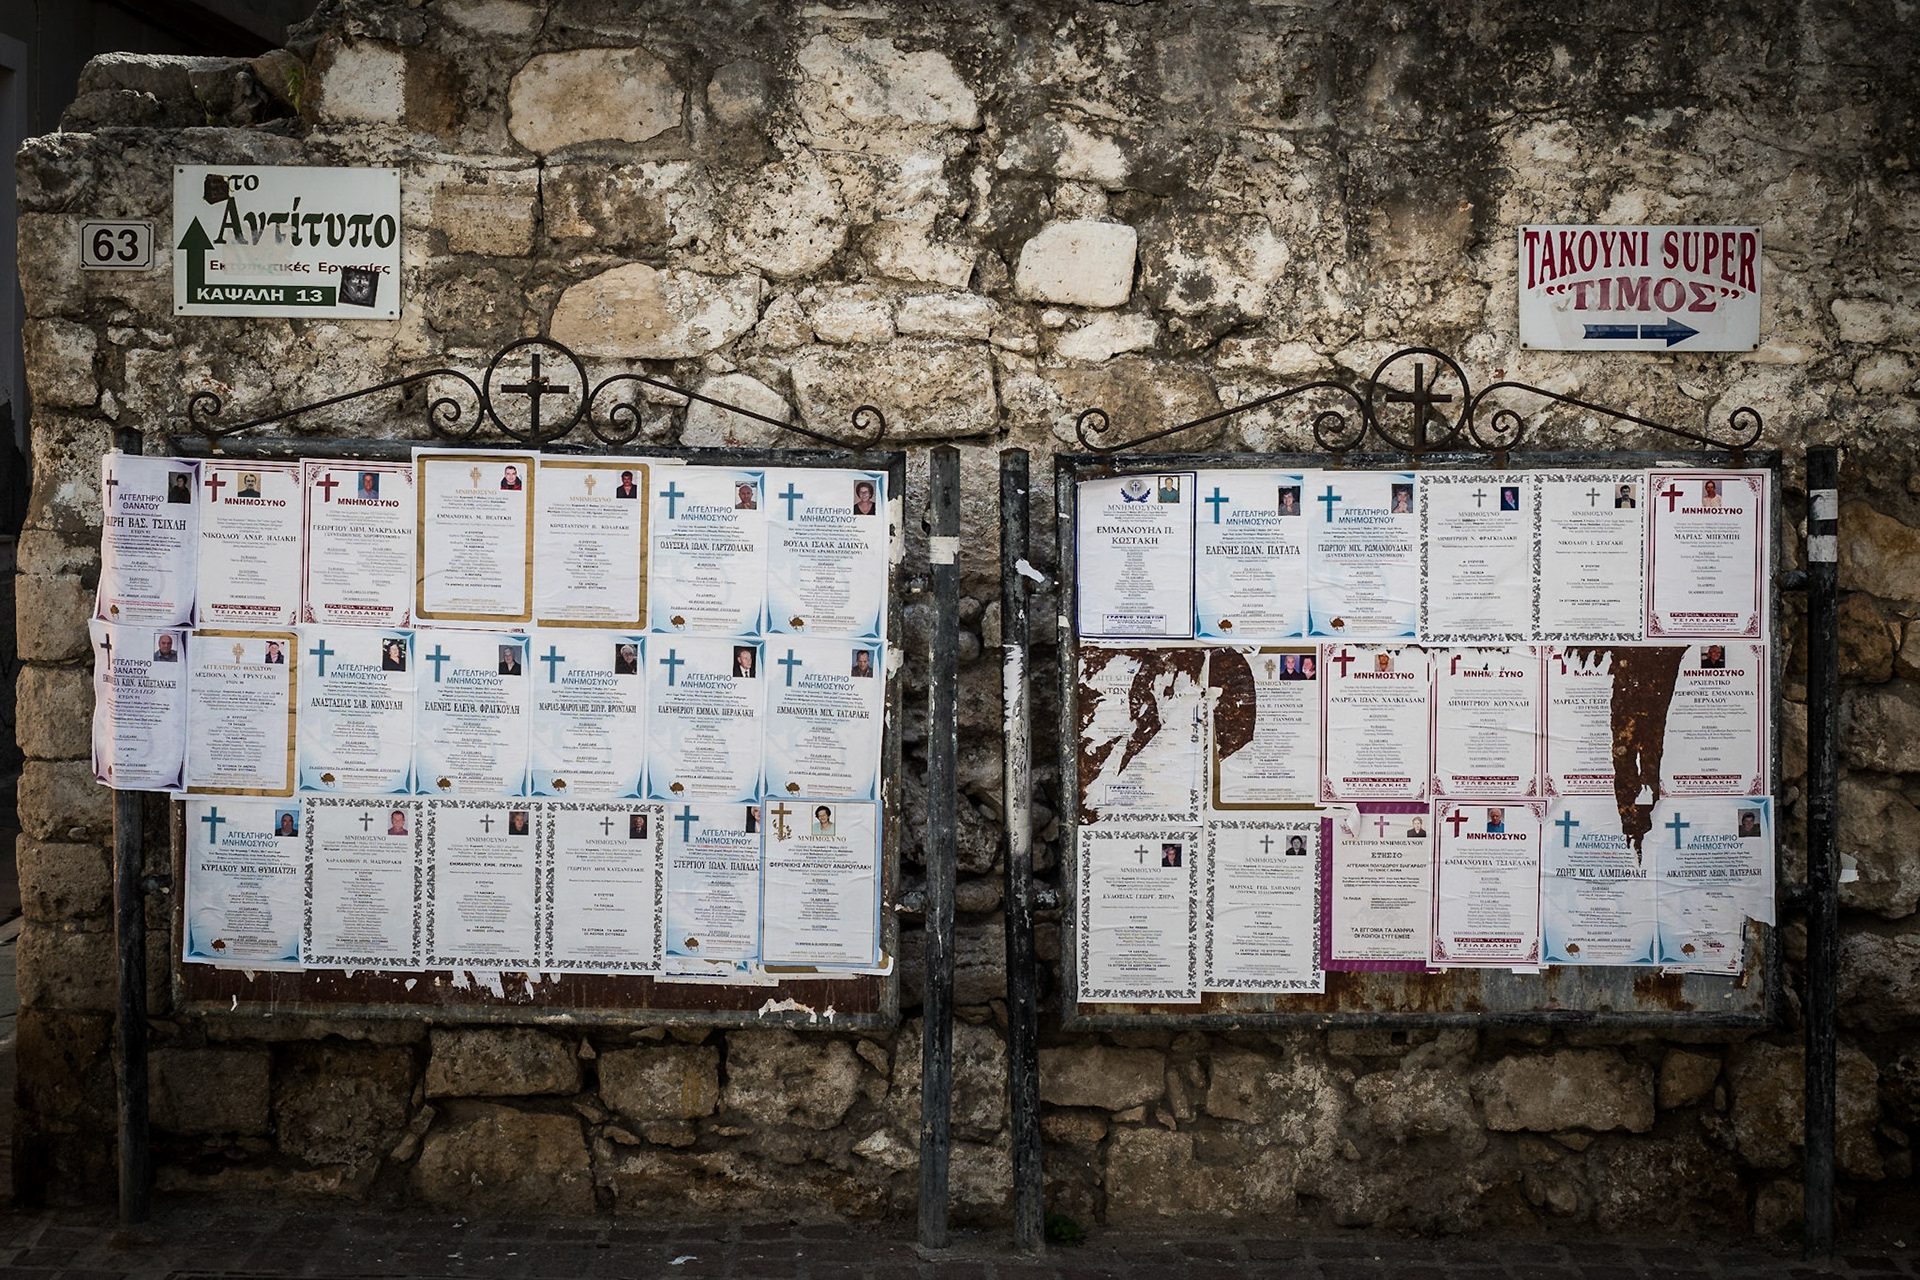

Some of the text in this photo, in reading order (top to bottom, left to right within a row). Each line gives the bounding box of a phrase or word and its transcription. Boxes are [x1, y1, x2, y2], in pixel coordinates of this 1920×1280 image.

[230, 173, 259, 190] το
[214, 197, 396, 248] Αντίτυπο
[93, 229, 138, 262] 63
[1664, 231, 1756, 293] SUPER
[197, 289, 323, 301] ΚΑΨΑΛΗ 13
[123, 502, 159, 510] ΘΑΝΑΤΟΥ
[225, 498, 286, 507] ΜΝΗΜΟΣΥΝΟ
[338, 498, 399, 507] ΜΝΗΜΟΣΥΝΟ
[1232, 510, 1276, 518] ΑΓΓΕΛΤΗΡΙΟ
[1682, 507, 1743, 515] ΜΝΗΜΟΣΥΝΟ
[681, 513, 738, 521] ΜΝΗΜΟΣΥΝΟΥ
[800, 515, 857, 523] ΜΝΗΜΟΣΥΝΟΥ
[1338, 516, 1395, 524] ΜΝΗΜΟΣΥΝΟΥ
[129, 518, 186, 530] ΒΑΣ. ΤΣΙΧΛΗ
[1097, 526, 1161, 534] ΕΜΜΑΝΟΥΗΛ
[113, 659, 152, 667] ΓΓΕΛΤΗΡΙΟ
[337, 664, 381, 672] ΑΓΓΕΛΤΗΡΙΟ
[331, 672, 388, 680] ΜΝΗΜΟΣΥΝΟΥ
[453, 669, 497, 677] ΑΓΓΕΛΤΗΡΙΟ
[687, 673, 731, 681] ΑΓΓΕΛΤΗΡΙΟ
[447, 677, 503, 685] ΜΝΗΜΟΣΥΝΟΥ
[804, 674, 849, 682] ΑΓΓΕΛΤΗΡΙΟ
[681, 681, 737, 689] ΜΝΗΜΟΣΥΝΟΥ
[798, 682, 855, 690] ΜΝΗΜΟΣΥΝΟΥ
[777, 706, 817, 716] ΕΜΜΑΝΟΥΗΛ
[228, 831, 272, 839] ΑΓΓΕΛΤΗΡΙΟ
[222, 839, 279, 848] ΜΝΗΜΟΣΥΝΟΥ
[695, 837, 752, 845] ΜΝΗΜΟΣΥΝΟΥ
[1687, 842, 1744, 850] ΜΝΗΜΟΣΥΝΟΥ
[731, 861, 760, 871] ΠΑΠΑΔΑ
